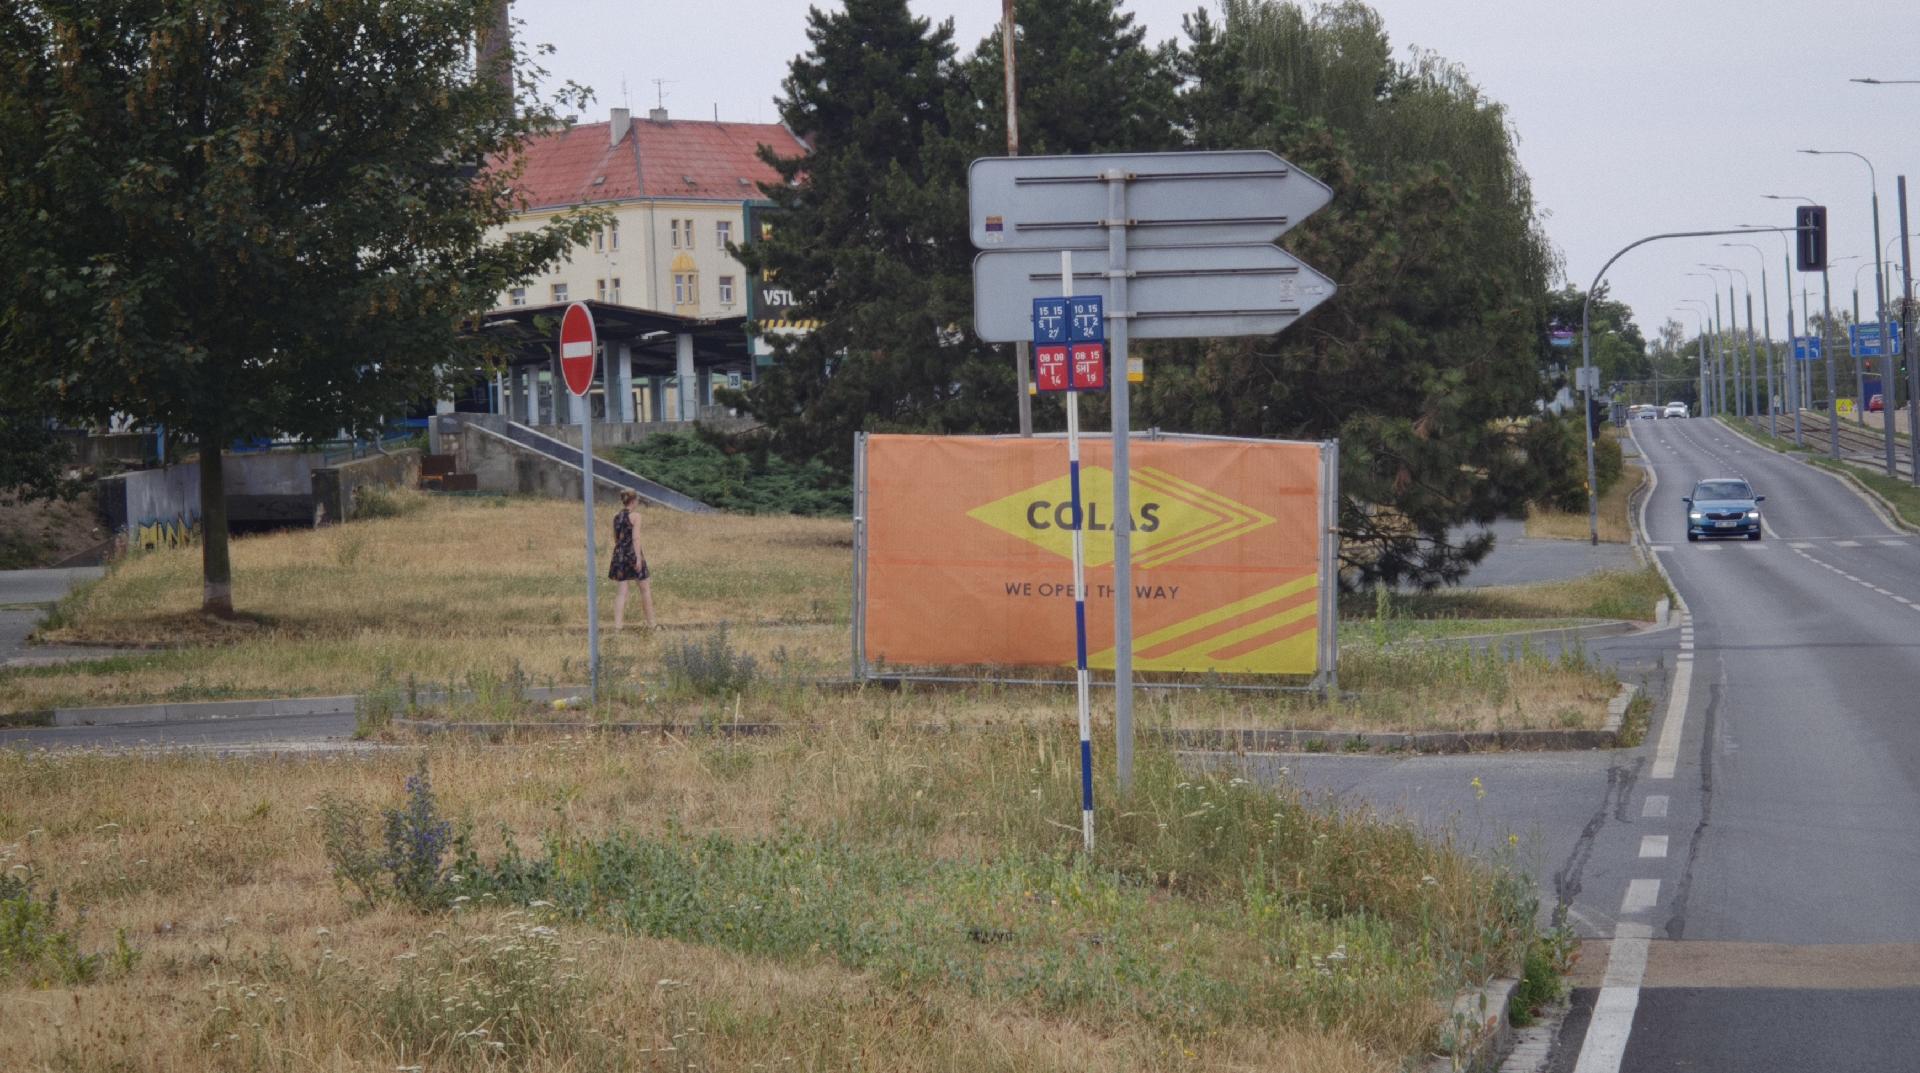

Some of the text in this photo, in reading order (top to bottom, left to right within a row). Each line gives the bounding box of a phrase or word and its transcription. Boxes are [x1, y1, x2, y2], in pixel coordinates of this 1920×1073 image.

[1039, 306, 1063, 316] 15 15
[1074, 304, 1098, 314] 10 15
[1090, 351, 1100, 361] 15
[1005, 583, 1031, 596] WE
[1097, 585, 1119, 598] TH
[1136, 586, 1179, 599] WAY
